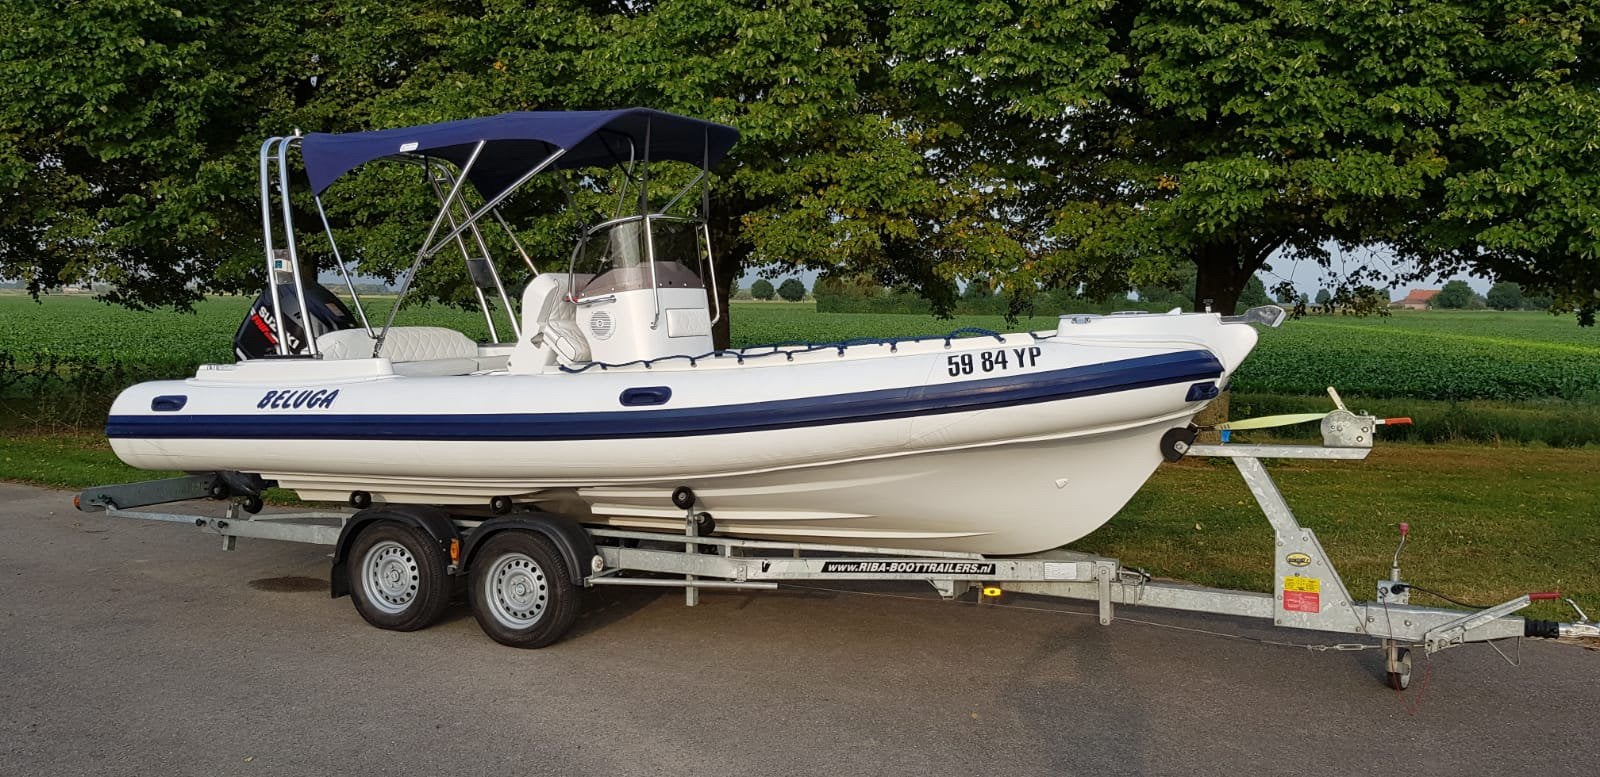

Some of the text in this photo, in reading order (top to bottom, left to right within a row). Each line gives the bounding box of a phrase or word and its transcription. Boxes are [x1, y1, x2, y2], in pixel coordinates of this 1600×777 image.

[258, 306, 300, 349] SUZKI
[947, 346, 1041, 377] 59 84 YP
[257, 388, 340, 409] BELUGA
[827, 561, 993, 574] www.RIBA-BOOTTRAILERS.nl
